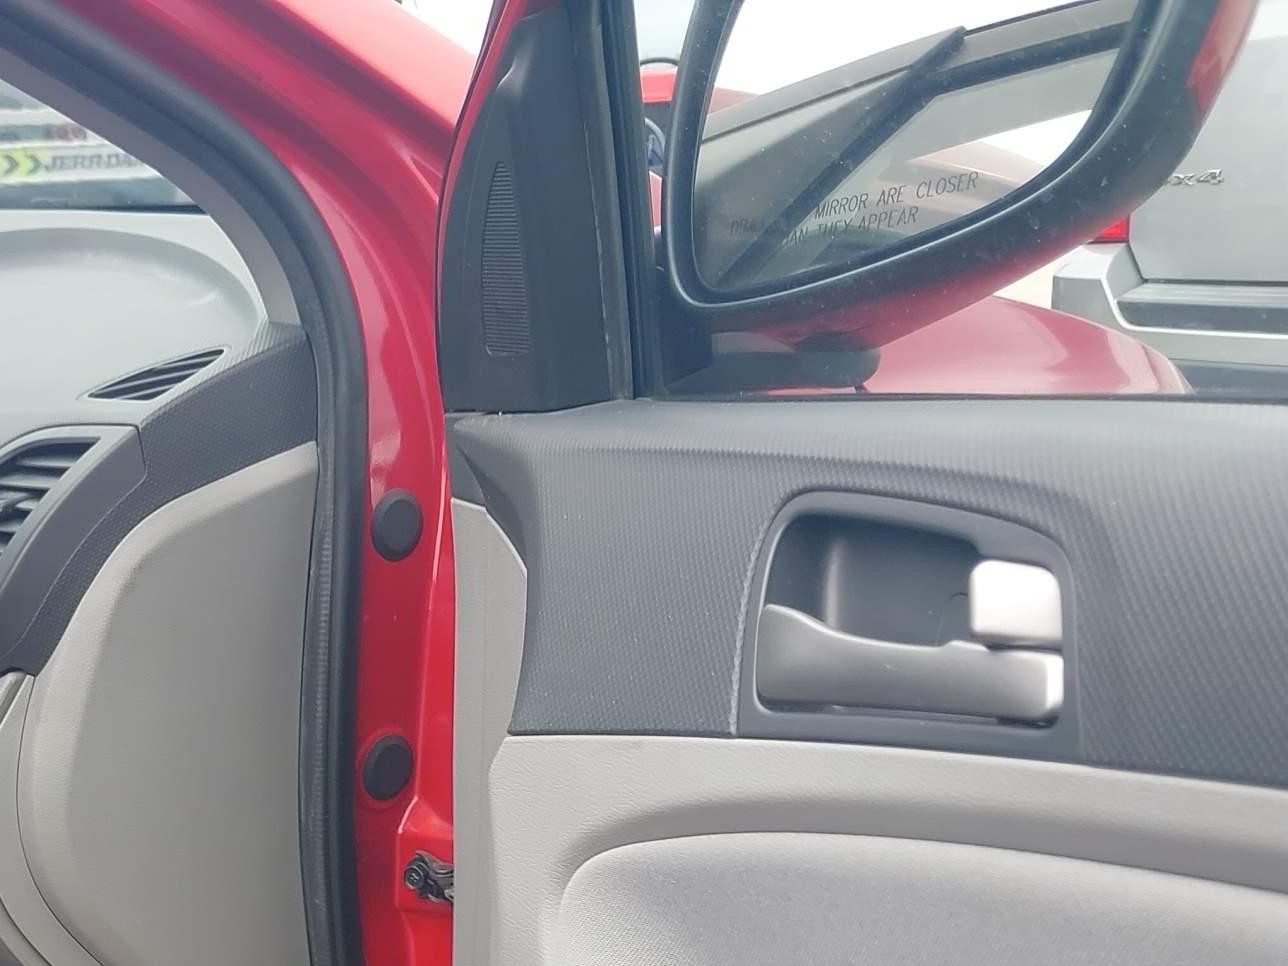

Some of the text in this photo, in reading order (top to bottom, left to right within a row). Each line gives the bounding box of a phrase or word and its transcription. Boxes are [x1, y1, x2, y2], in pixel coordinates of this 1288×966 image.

[1167, 169, 1224, 186] x4
[814, 171, 980, 220] MIRROR ARE CLOSER
[858, 206, 919, 233] APPEAR
